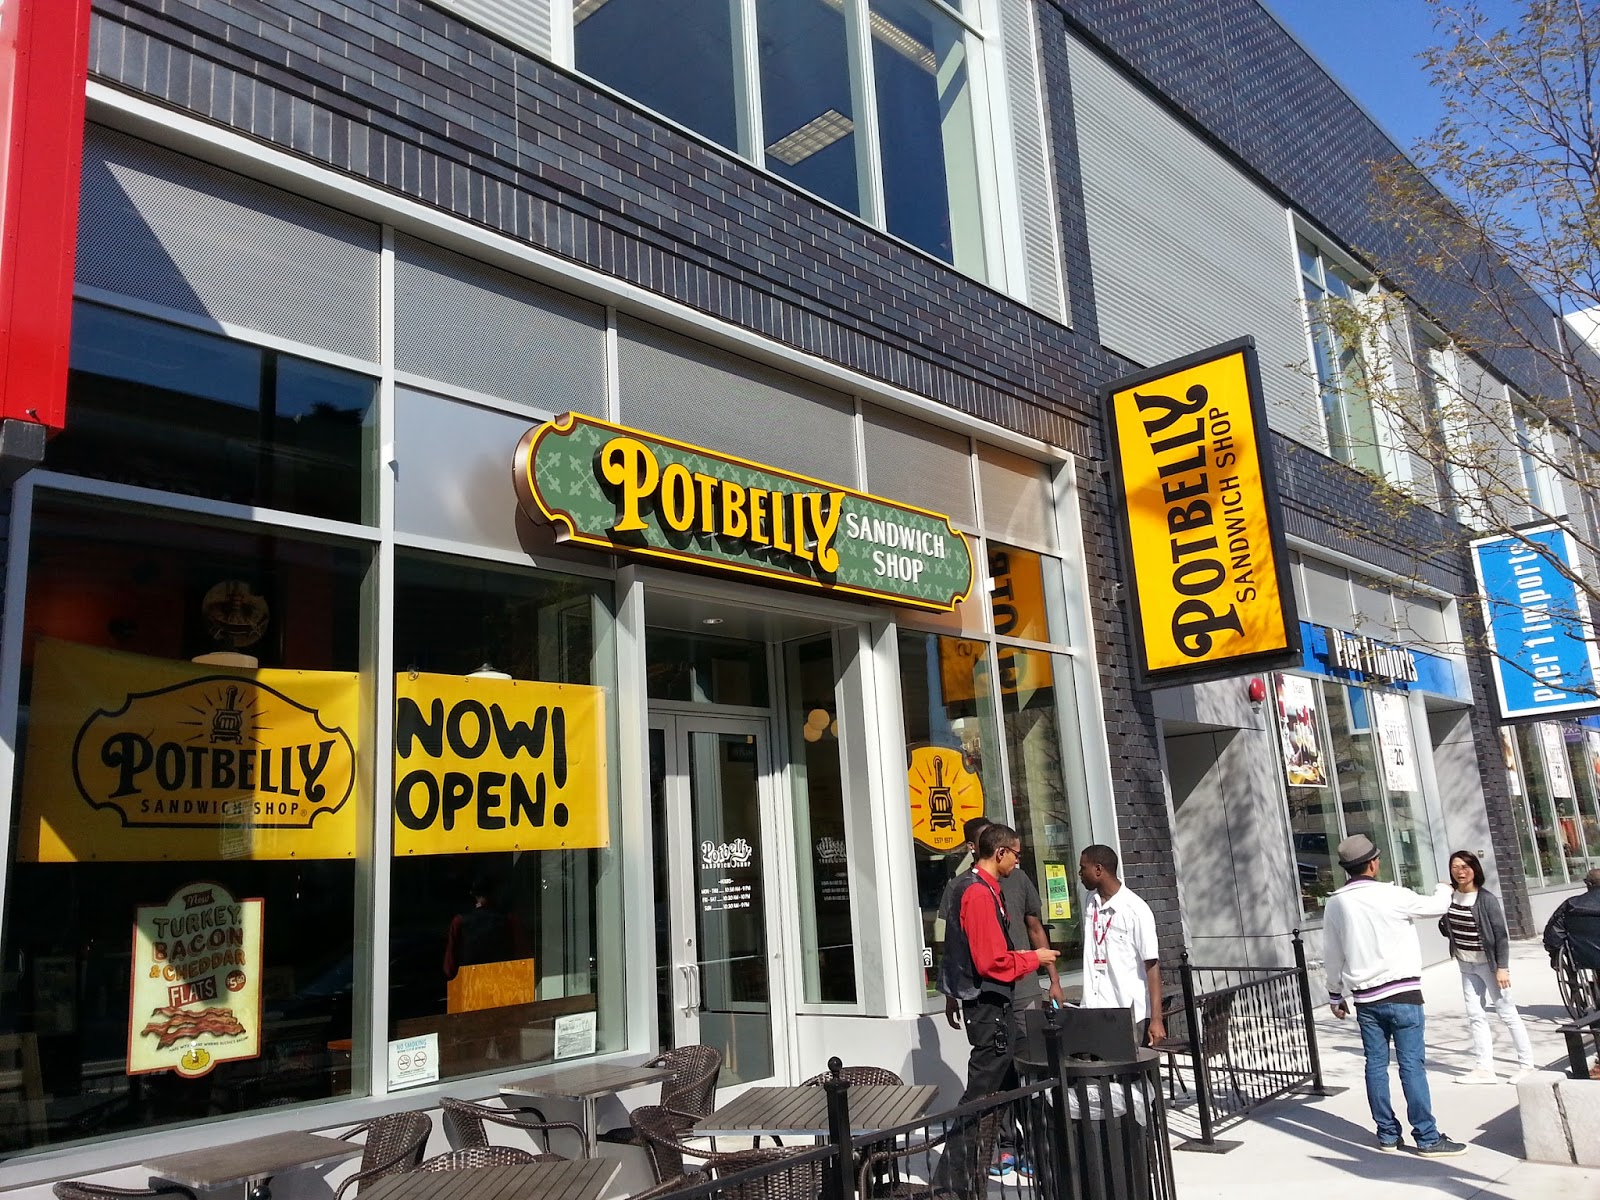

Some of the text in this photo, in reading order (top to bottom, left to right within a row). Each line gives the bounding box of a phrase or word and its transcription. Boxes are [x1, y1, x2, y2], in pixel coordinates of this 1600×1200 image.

[599, 437, 846, 574] POTBELLY
[1133, 383, 1245, 658] POTBELLY
[1209, 407, 1257, 603] SANDWICH SHOP
[846, 512, 946, 559] SANDWICH
[873, 550, 924, 584] SHOP
[101, 729, 337, 803] POTBELLY
[140, 799, 299, 815] SANDWICH SHOP
[187, 893, 211, 905] New
[152, 927, 244, 964] BACON
[149, 948, 247, 982] & CHEDDAR
[170, 979, 214, 1007] FLATS
